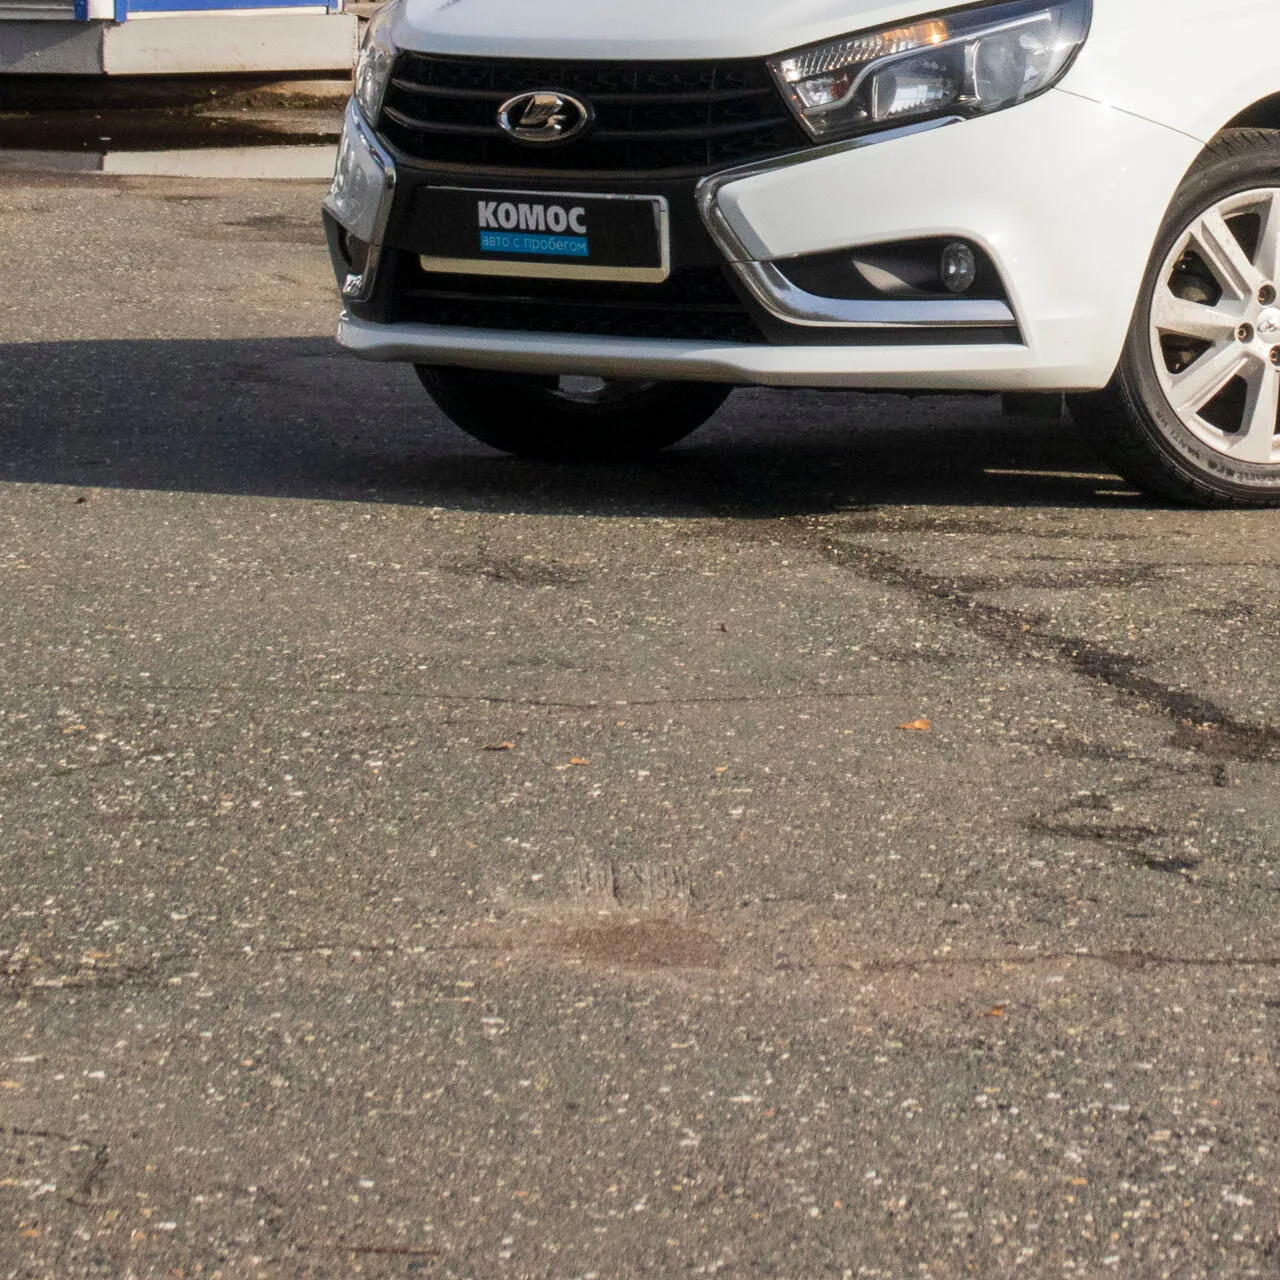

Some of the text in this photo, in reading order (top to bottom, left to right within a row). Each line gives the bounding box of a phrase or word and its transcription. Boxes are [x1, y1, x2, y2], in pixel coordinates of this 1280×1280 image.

[478, 201, 587, 234] КОМОС
[483, 235, 587, 253] авто с пробегом
